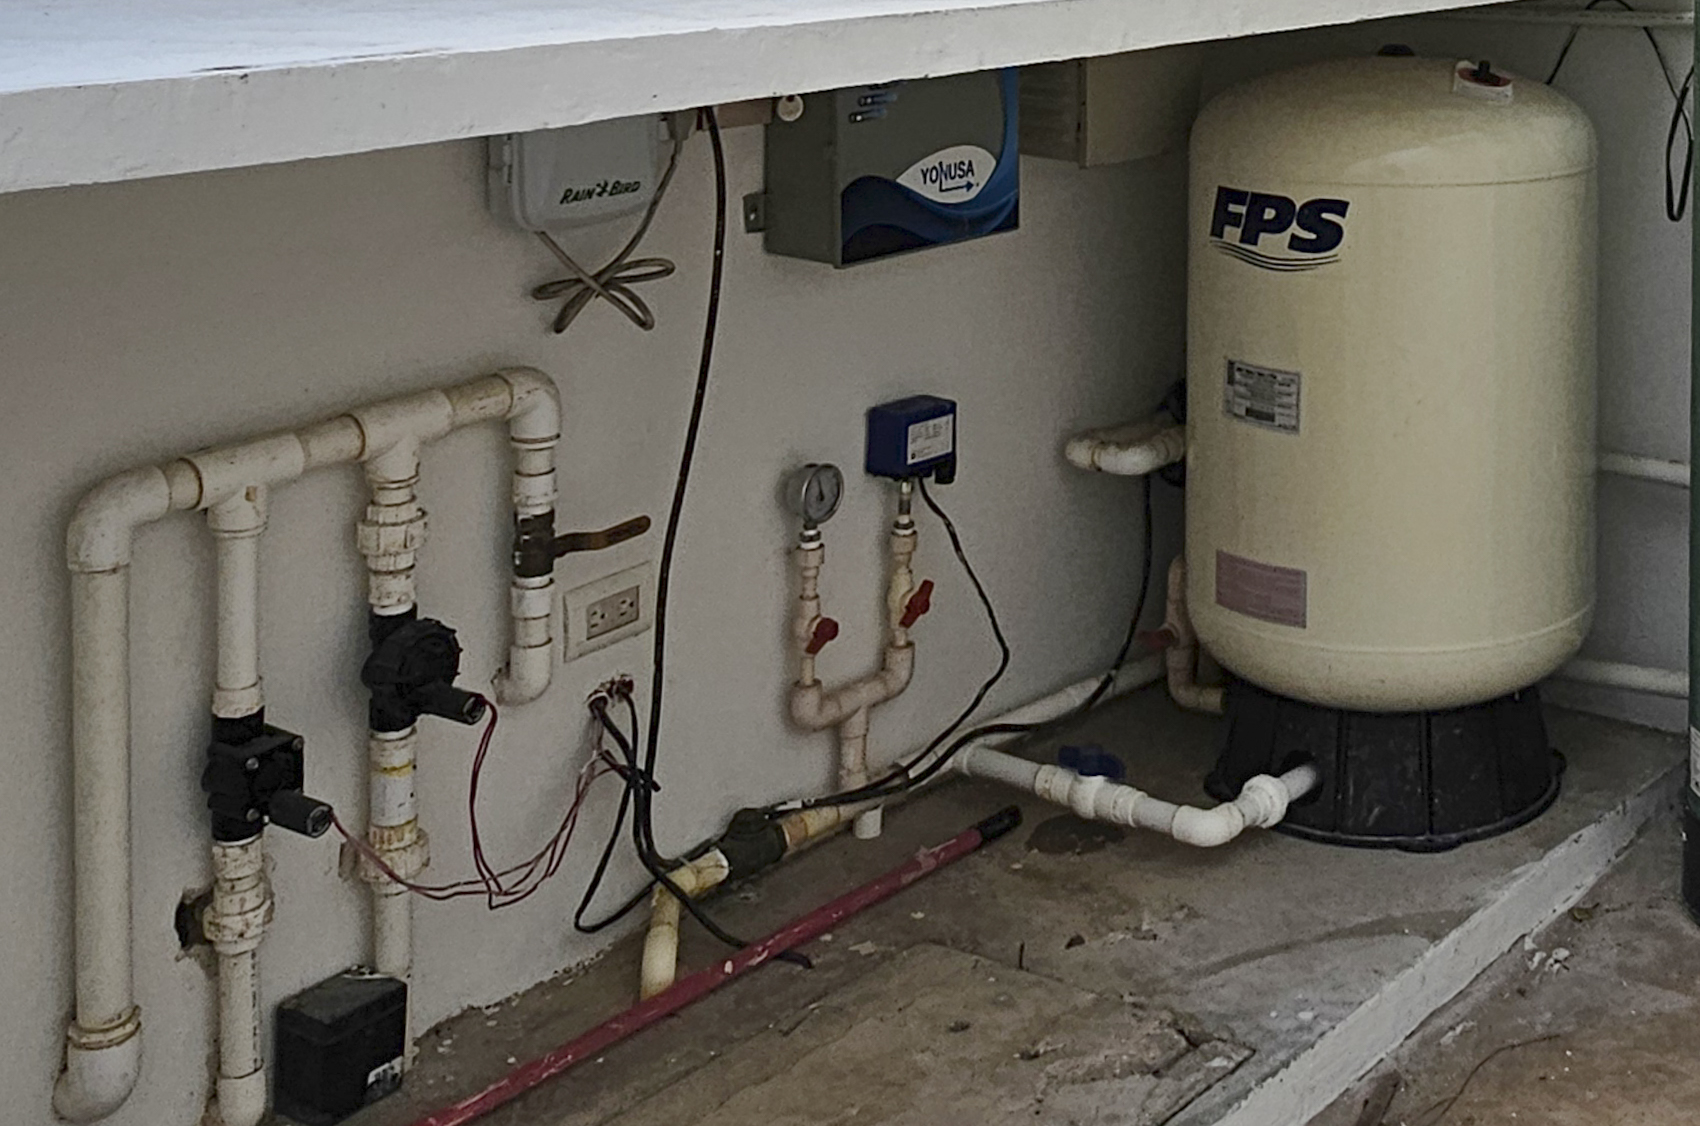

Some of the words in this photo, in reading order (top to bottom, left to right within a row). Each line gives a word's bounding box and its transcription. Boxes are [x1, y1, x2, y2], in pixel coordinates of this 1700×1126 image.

[921, 159, 975, 185] YONUSA
[559, 187, 596, 205] RAIN
[608, 179, 641, 196] BIRD
[1209, 185, 1350, 254] FPS
